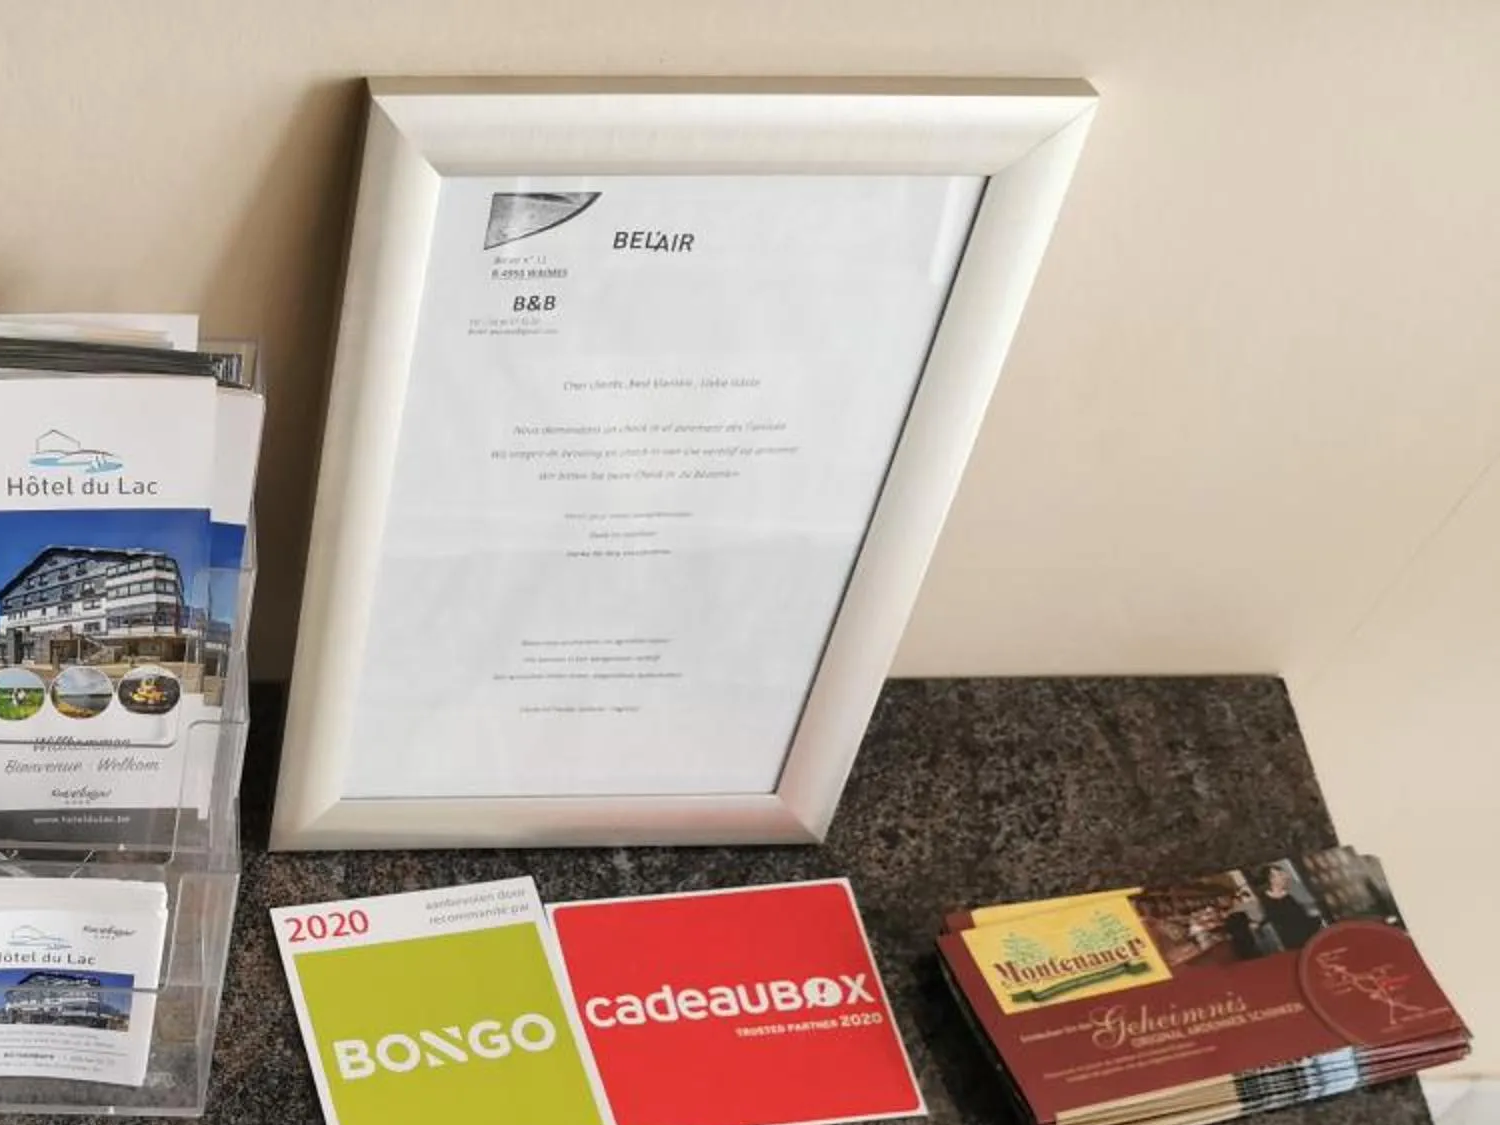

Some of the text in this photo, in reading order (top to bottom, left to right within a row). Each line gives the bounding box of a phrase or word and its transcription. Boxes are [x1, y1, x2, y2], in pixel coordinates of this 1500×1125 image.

[513, 295, 557, 311] B&B
[7, 471, 159, 497] Hôtel du Lac
[4, 757, 160, 774] Bienvenue Welkom
[285, 909, 370, 943] 2020
[41, 951, 62, 963] du
[67, 953, 96, 966] Lac
[736, 1011, 883, 1038] TRUSTED PARTNER 2020
[1092, 991, 1248, 1048] Geheimnis
[333, 1012, 557, 1081] BONGO
